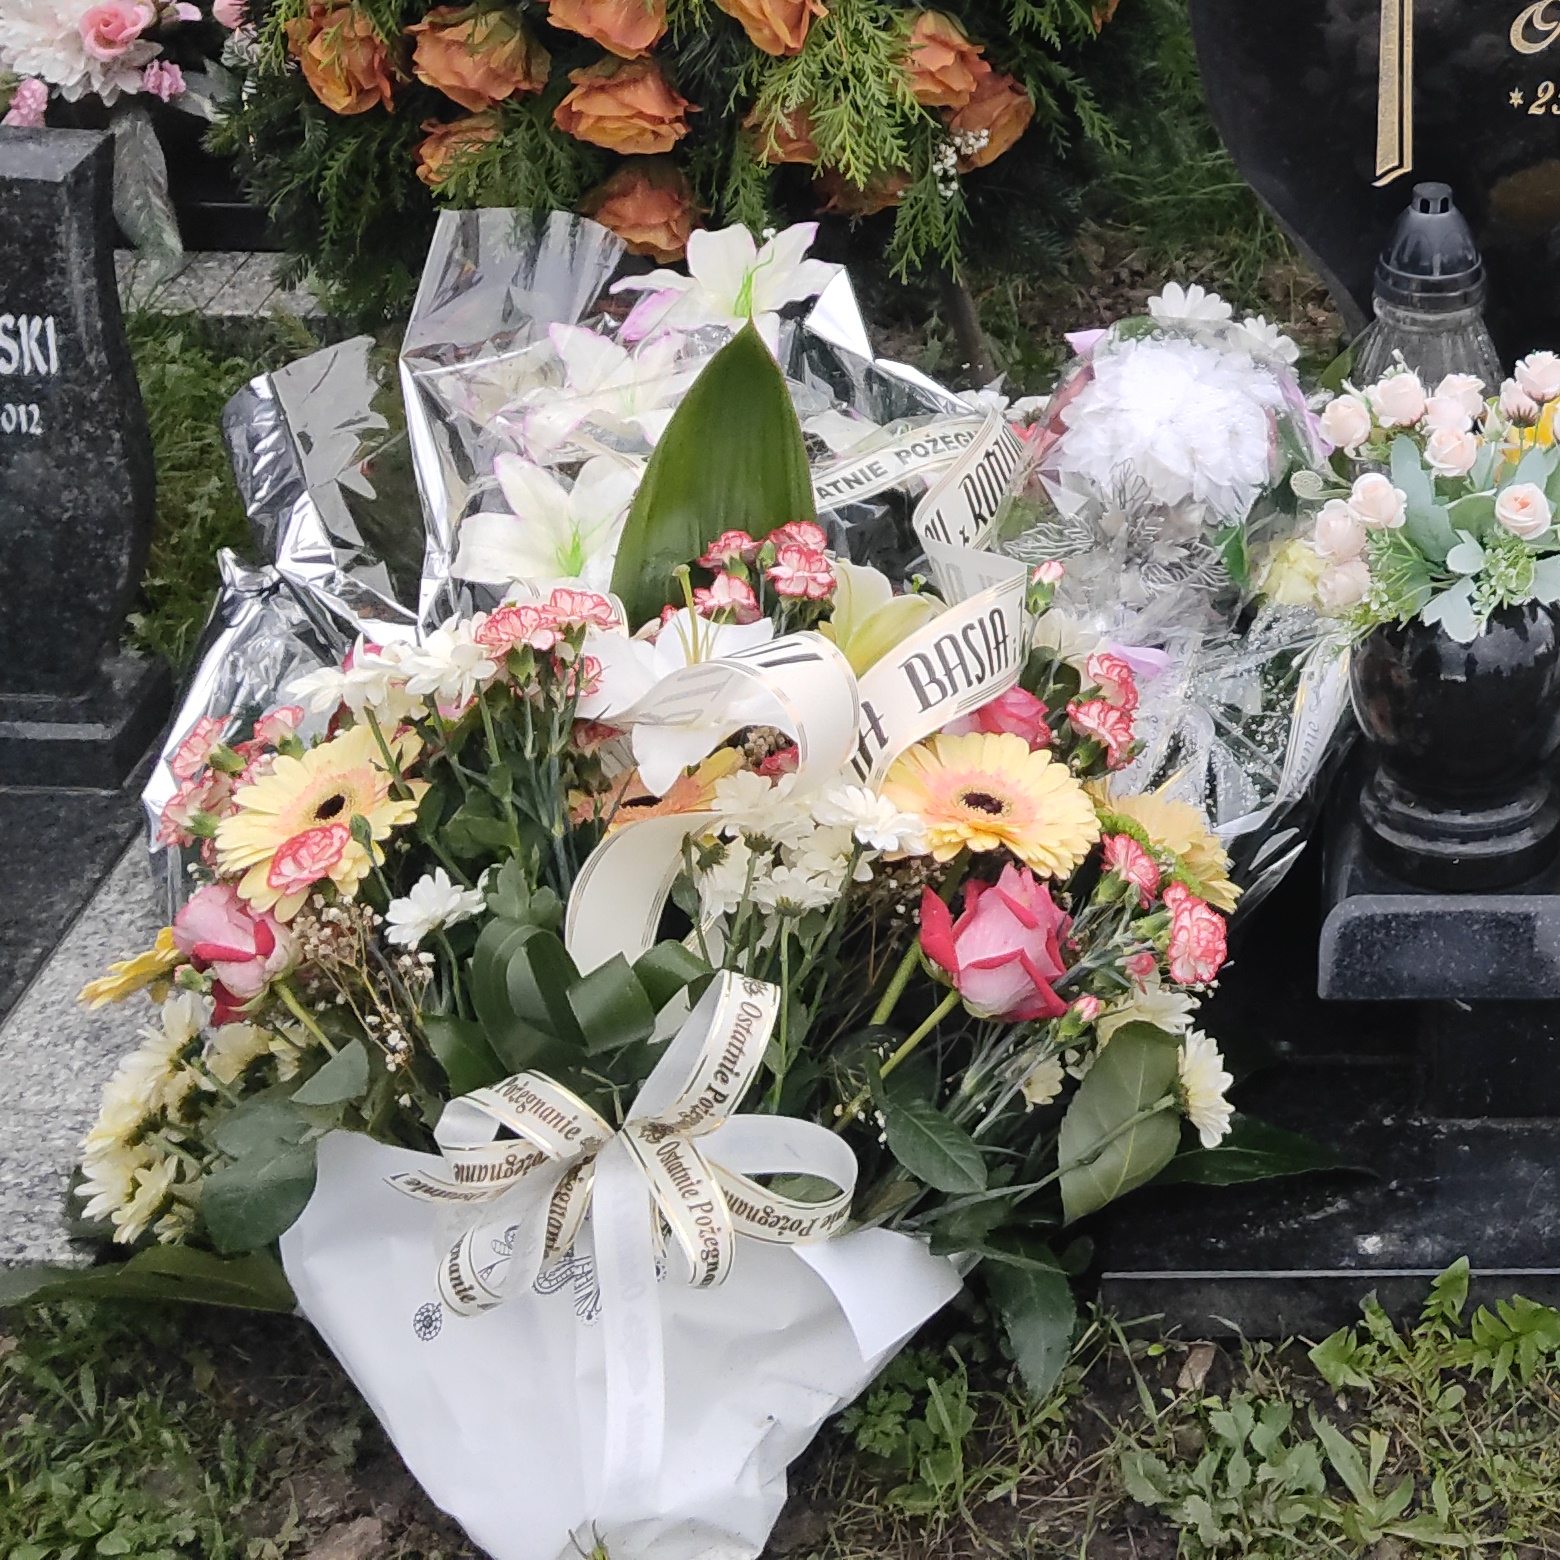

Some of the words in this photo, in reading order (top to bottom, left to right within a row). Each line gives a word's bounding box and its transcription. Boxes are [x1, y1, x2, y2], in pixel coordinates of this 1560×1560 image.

[897, 607, 1010, 715] BASIA
[712, 1000, 763, 1086] Ostatnie
[497, 1076, 582, 1141] Pożegnanie
[656, 1140, 703, 1198] Ostatnie
